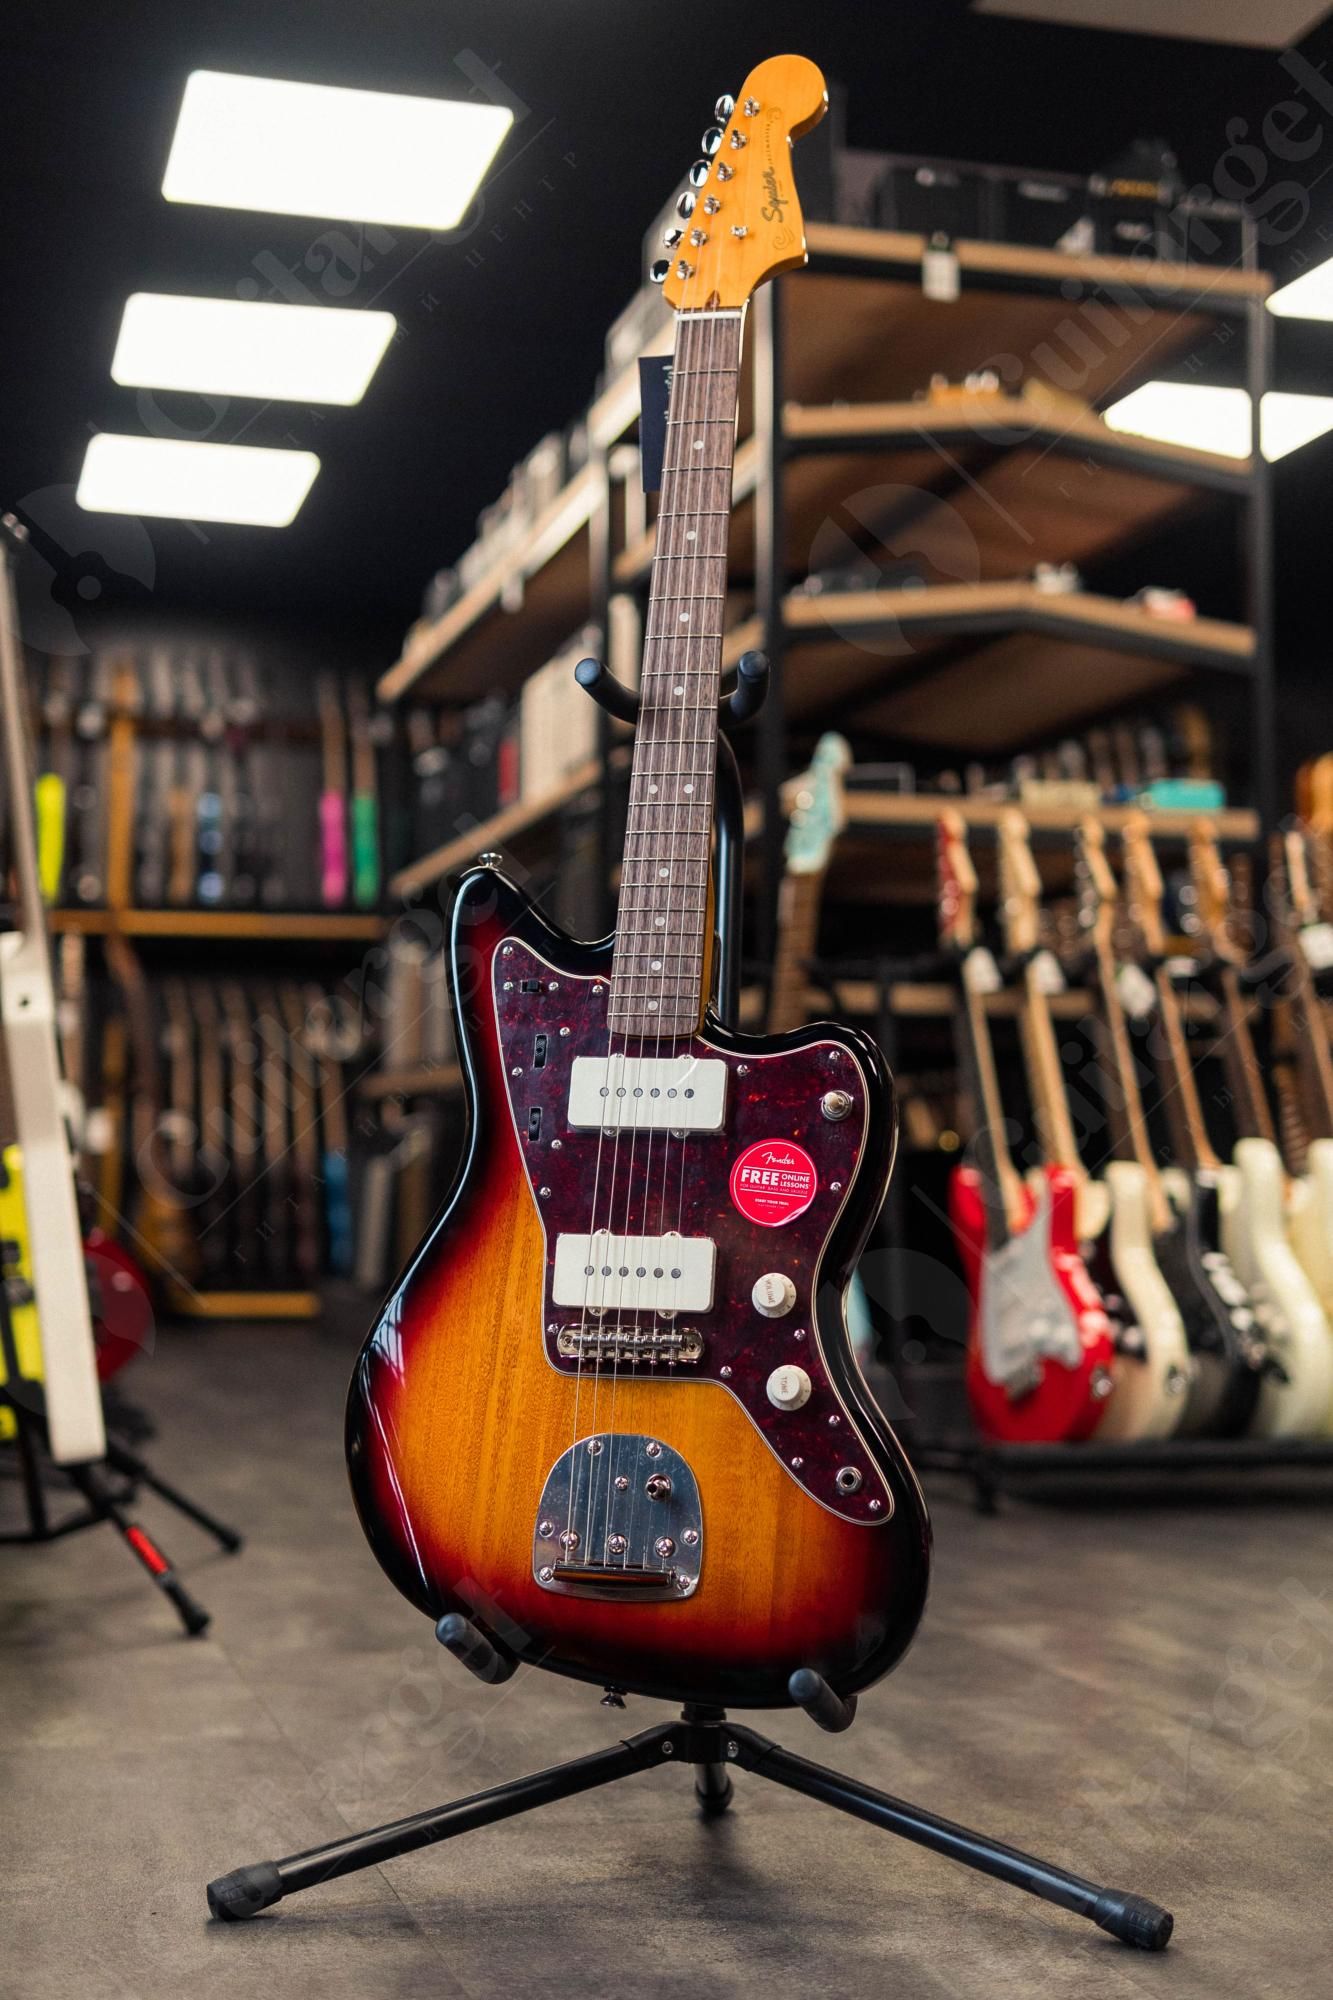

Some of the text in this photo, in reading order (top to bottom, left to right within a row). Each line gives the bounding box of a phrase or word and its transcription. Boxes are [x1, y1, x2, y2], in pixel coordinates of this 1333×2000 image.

[760, 166, 789, 223] Squier
[761, 1151, 795, 1165] Fender
[741, 1169, 811, 1186] FREE ONLINE
[780, 1181, 809, 1190] LESSONS
[780, 1376, 789, 1394] TONE
